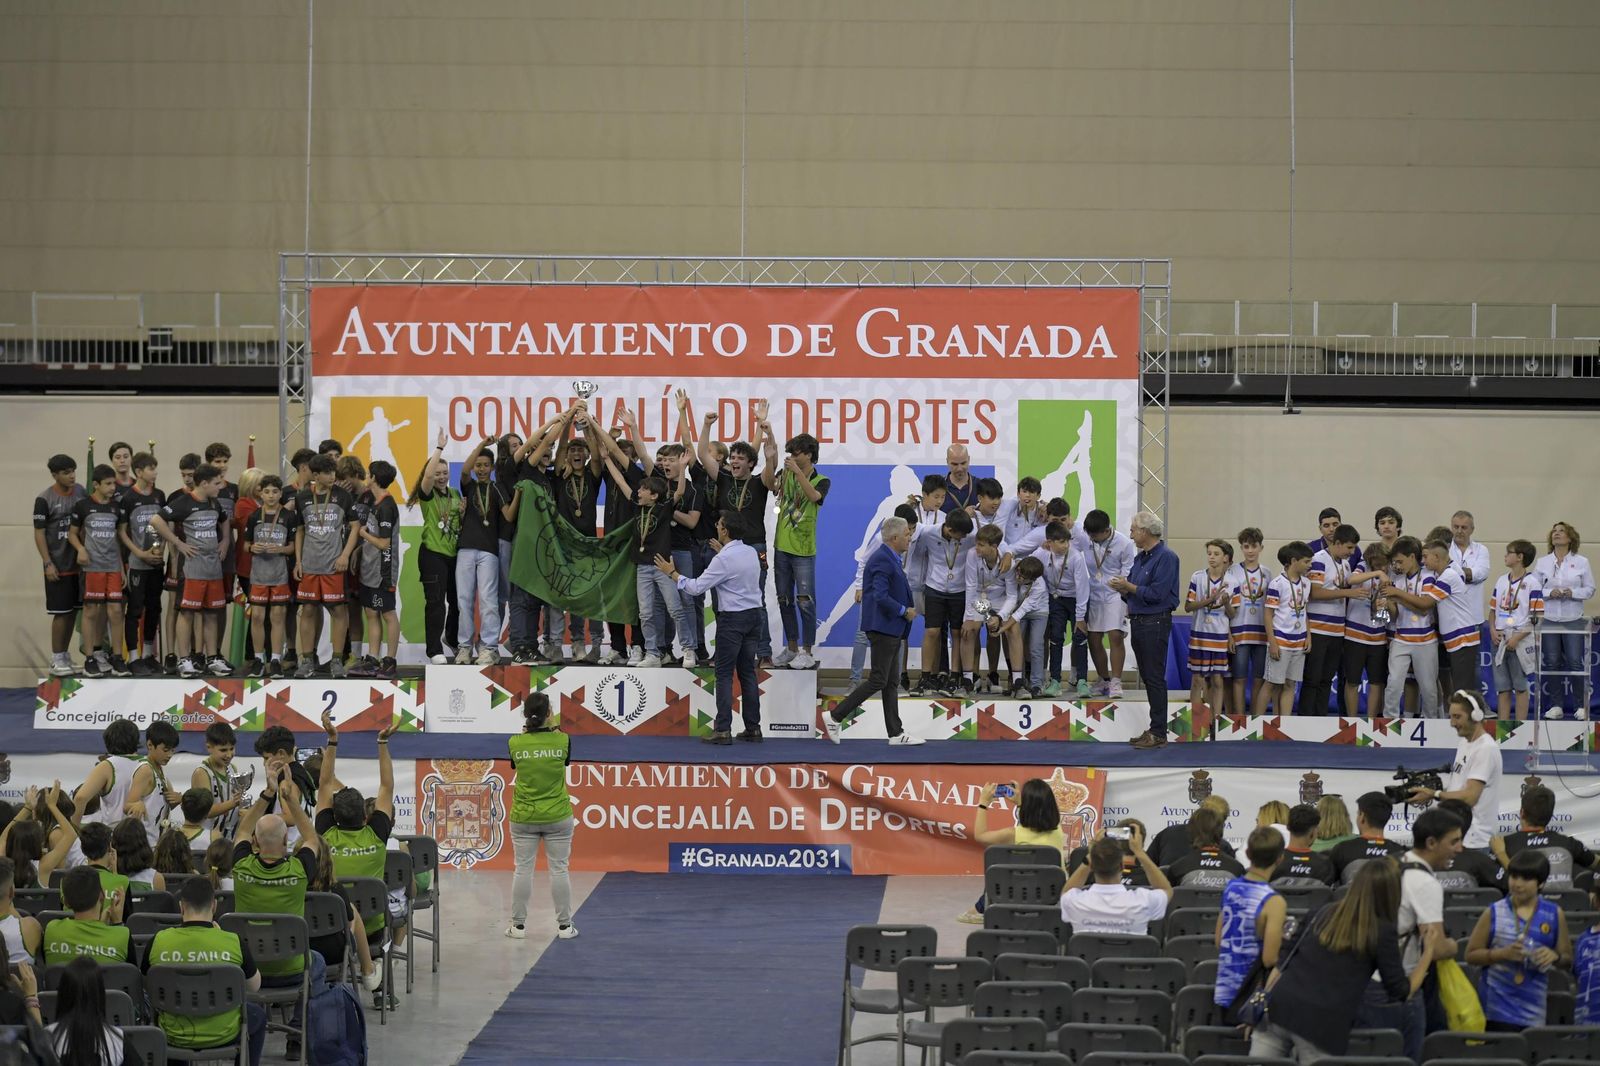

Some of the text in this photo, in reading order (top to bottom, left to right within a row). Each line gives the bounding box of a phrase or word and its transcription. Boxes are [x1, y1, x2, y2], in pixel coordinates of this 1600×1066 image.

[333, 305, 1117, 360] AYUNTAMIENTO DE GRANADA
[786, 398, 998, 444] DEPORTES
[322, 690, 338, 721] 2
[614, 681, 624, 716] 1
[46, 710, 215, 726] Concejalía de Deportes
[1019, 704, 1032, 729] 3
[1410, 720, 1427, 746] 4
[515, 749, 563, 759] C.D. SMILO
[508, 764, 777, 790] UNTAMIENTO
[790, 766, 830, 791] DE
[769, 805, 806, 831] DE
[820, 796, 968, 840] DEPORTES
[1366, 847, 1388, 856] vive
[1527, 836, 1549, 846] vive
[682, 847, 841, 868] #GRANADA2031
[1200, 858, 1222, 867] vive
[1290, 863, 1311, 874] vive
[50, 942, 72, 954] C.D.
[160, 951, 184, 962] C.D.
